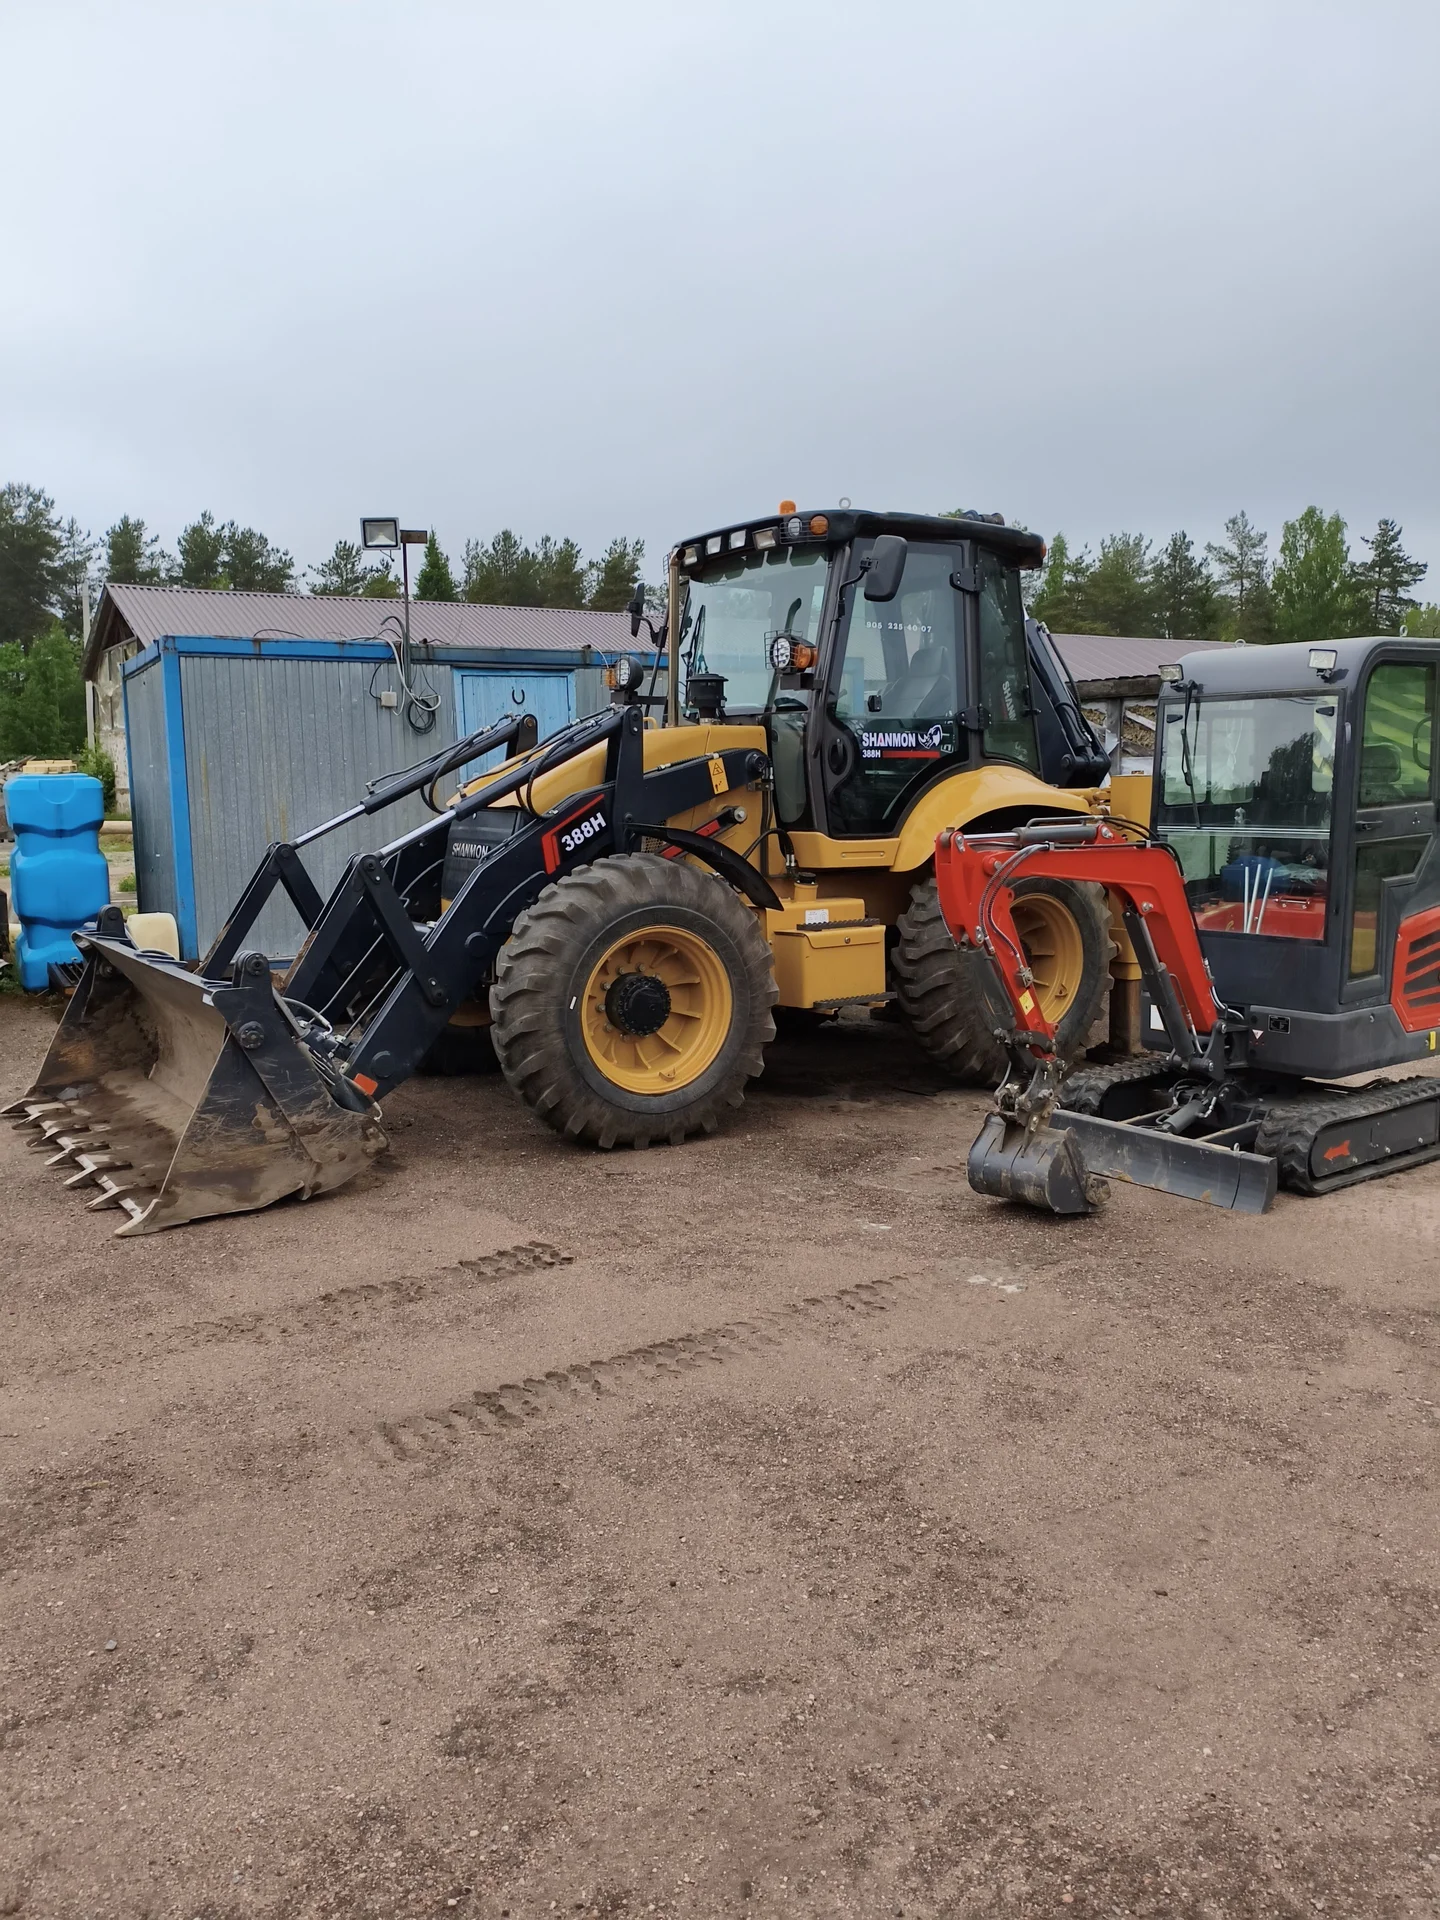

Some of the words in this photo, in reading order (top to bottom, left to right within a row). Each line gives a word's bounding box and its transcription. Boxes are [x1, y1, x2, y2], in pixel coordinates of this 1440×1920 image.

[887, 622, 903, 631] 225
[907, 624, 918, 632] 40
[921, 625, 932, 633] 07
[862, 732, 916, 747] SHANMON
[862, 749, 881, 758] 388H
[561, 812, 607, 851] 388H
[451, 842, 489, 859] SHANMON
